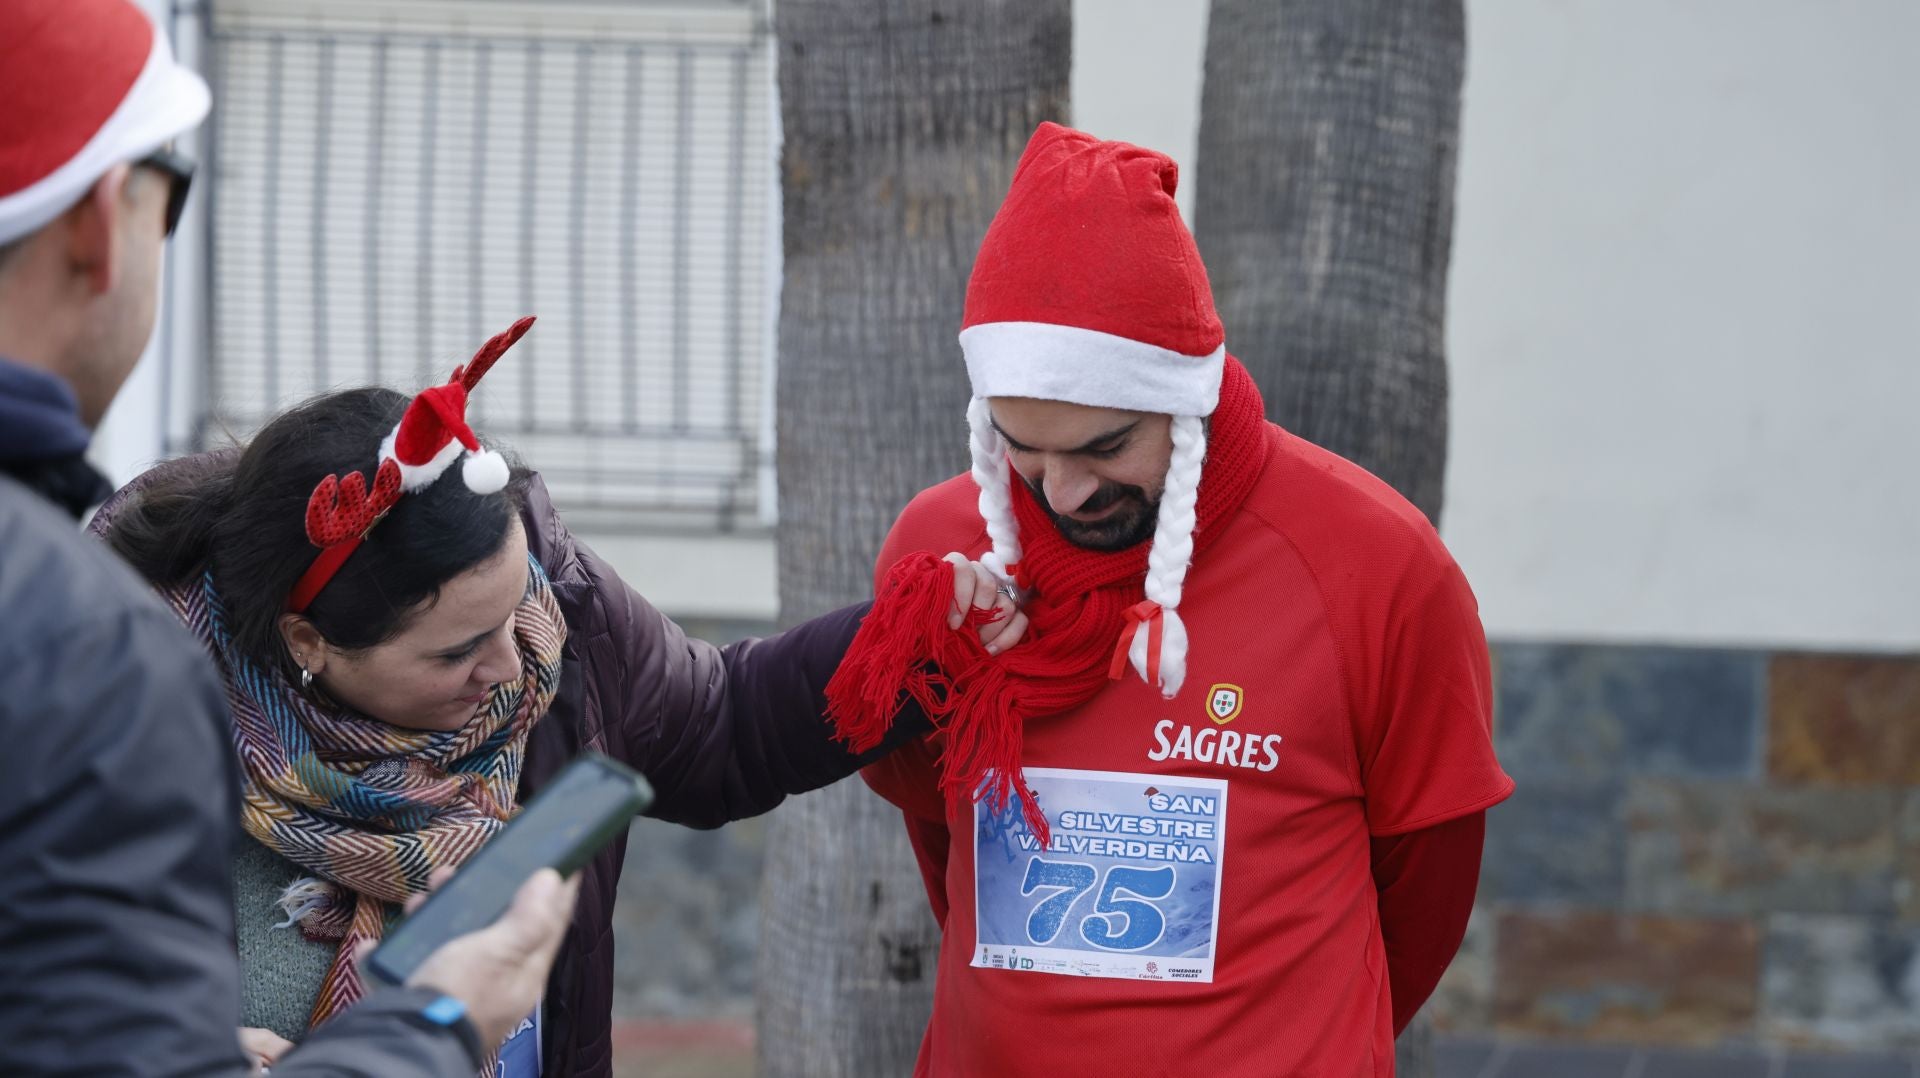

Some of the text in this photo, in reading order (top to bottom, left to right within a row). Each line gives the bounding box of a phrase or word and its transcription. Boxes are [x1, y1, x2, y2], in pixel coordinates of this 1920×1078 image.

[1148, 719, 1282, 772] SAGRES
[1150, 795, 1215, 815] SAN
[1060, 811, 1214, 839] SILVESTRE
[1018, 834, 1212, 864] VLVERDEÑA
[1021, 855, 1177, 952] 75
